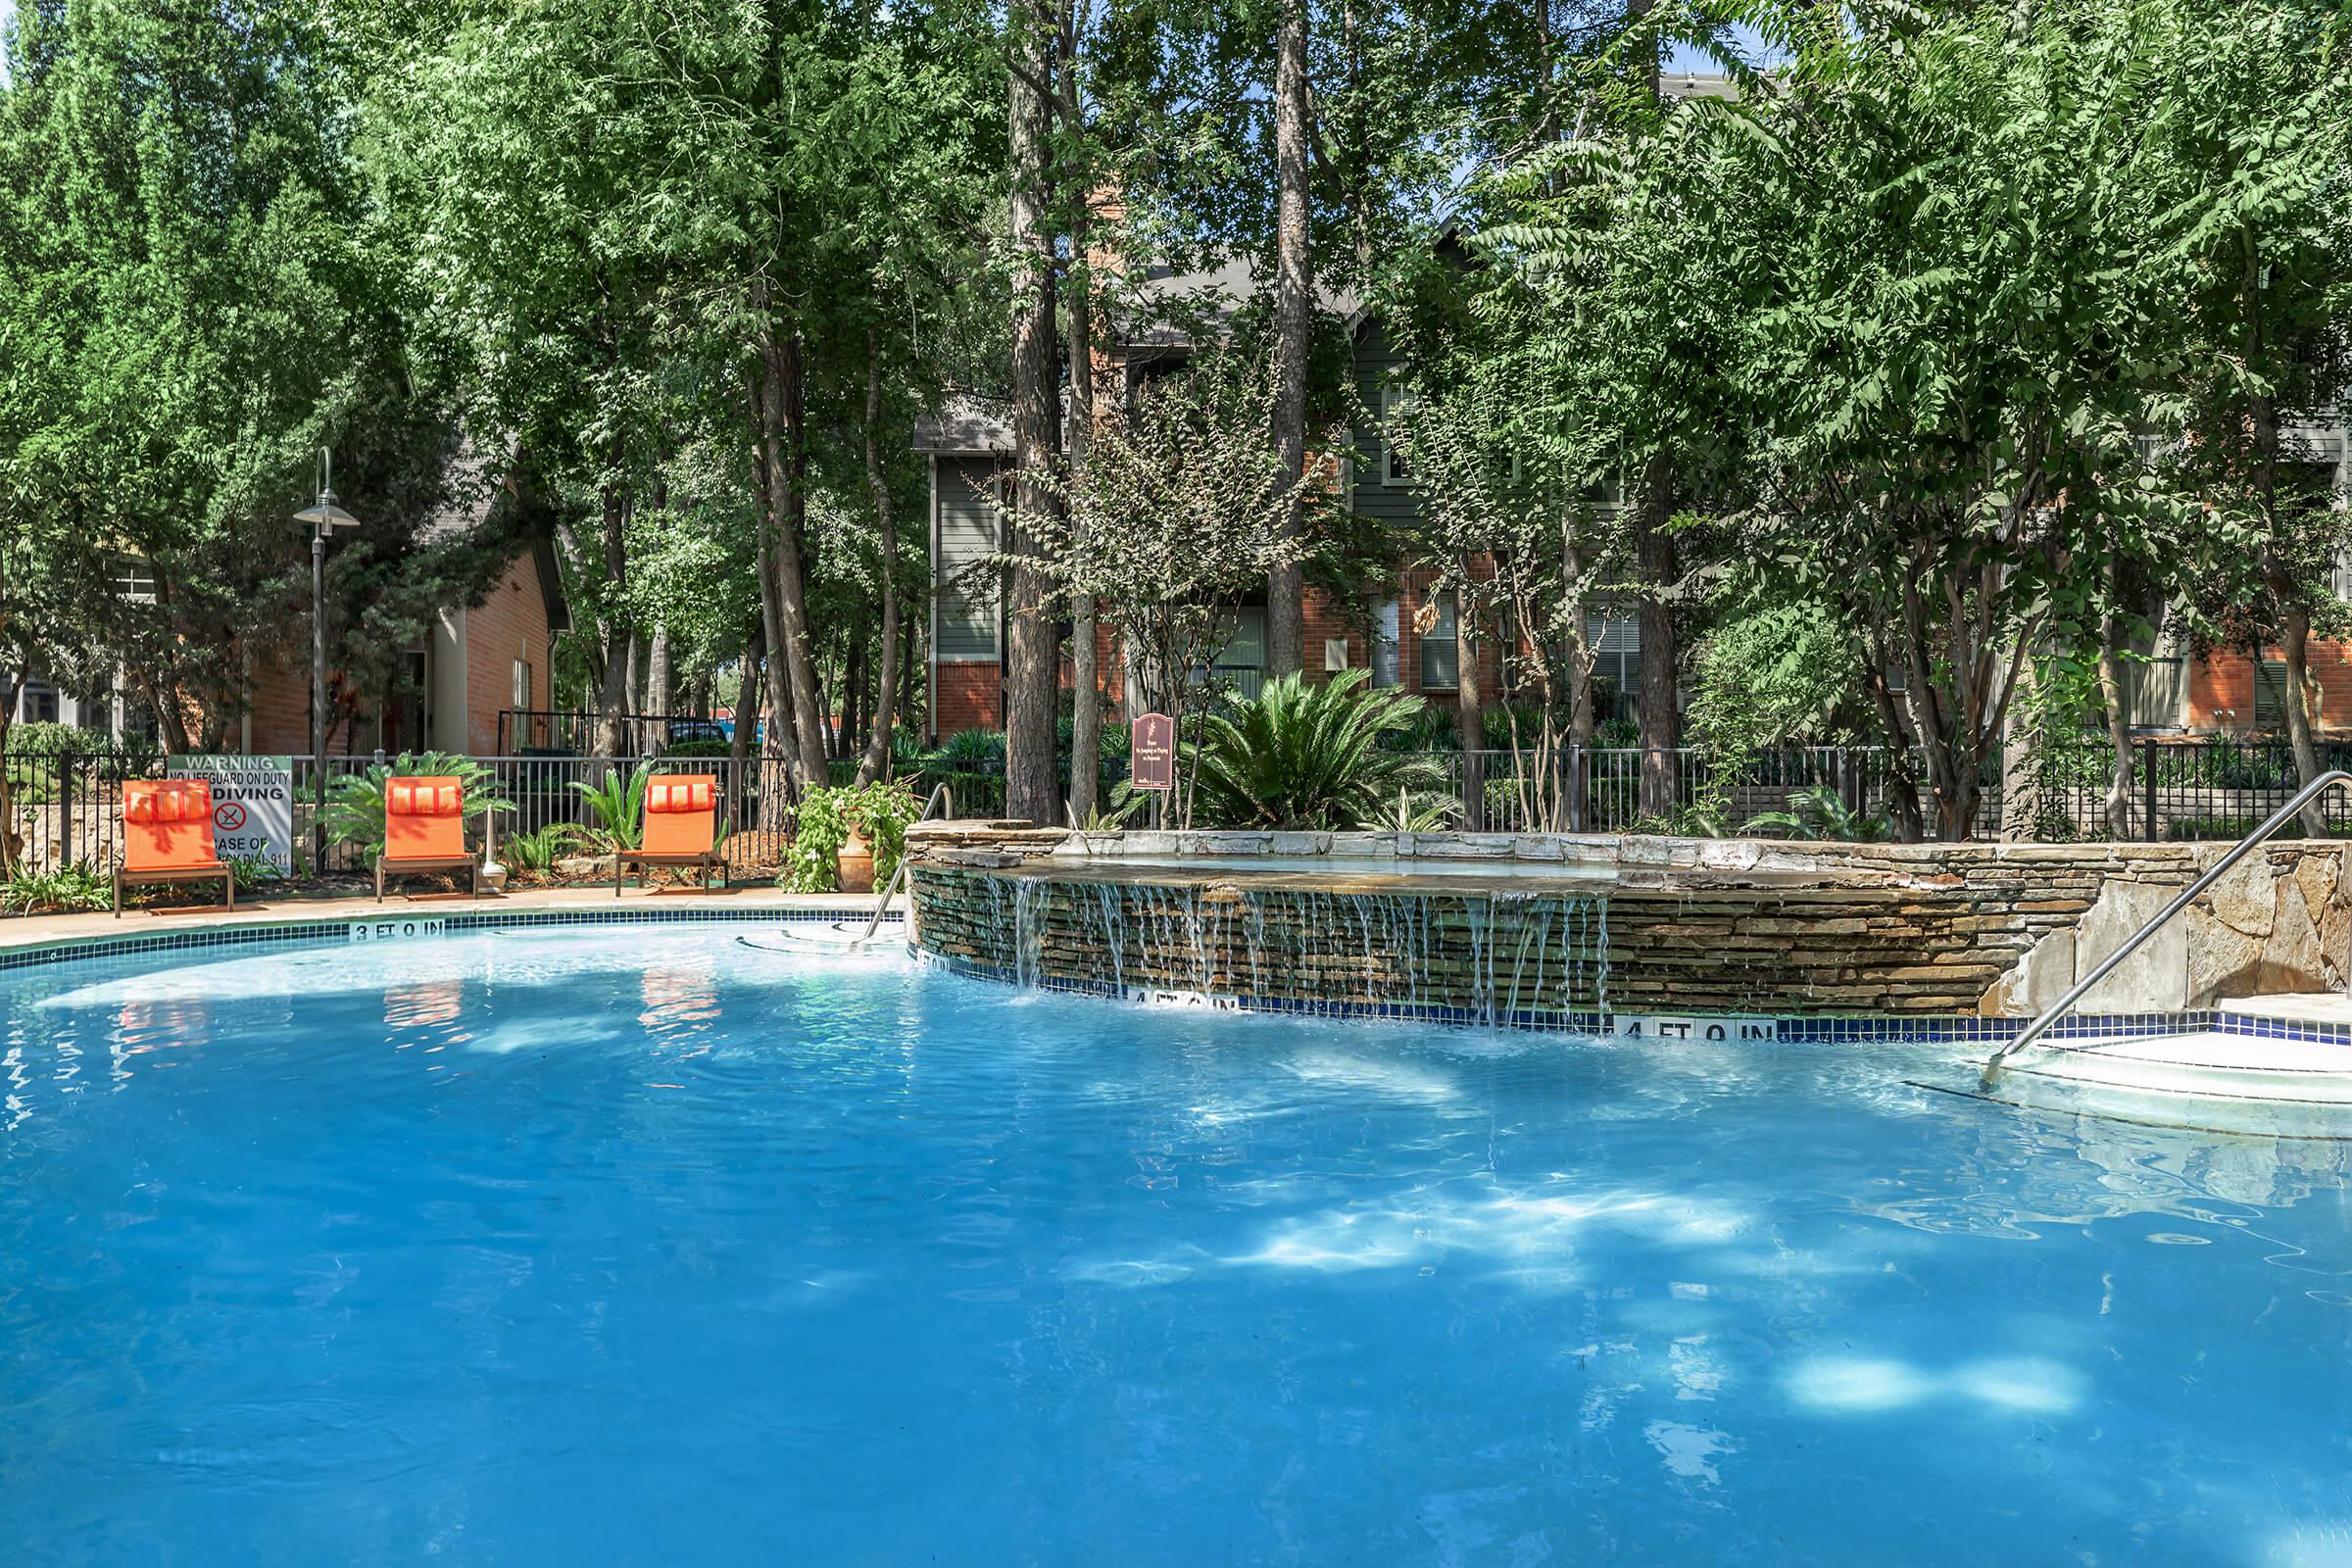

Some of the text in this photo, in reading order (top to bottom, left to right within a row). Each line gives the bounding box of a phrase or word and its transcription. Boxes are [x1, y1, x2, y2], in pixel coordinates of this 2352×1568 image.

[185, 756, 274, 769] WARNING
[246, 772, 261, 785] ON
[263, 772, 289, 785] DUTY
[213, 788, 283, 800] DIVING
[270, 853, 287, 865] 911
[423, 921, 443, 936] IN
[1740, 1025, 1773, 1042] IN
